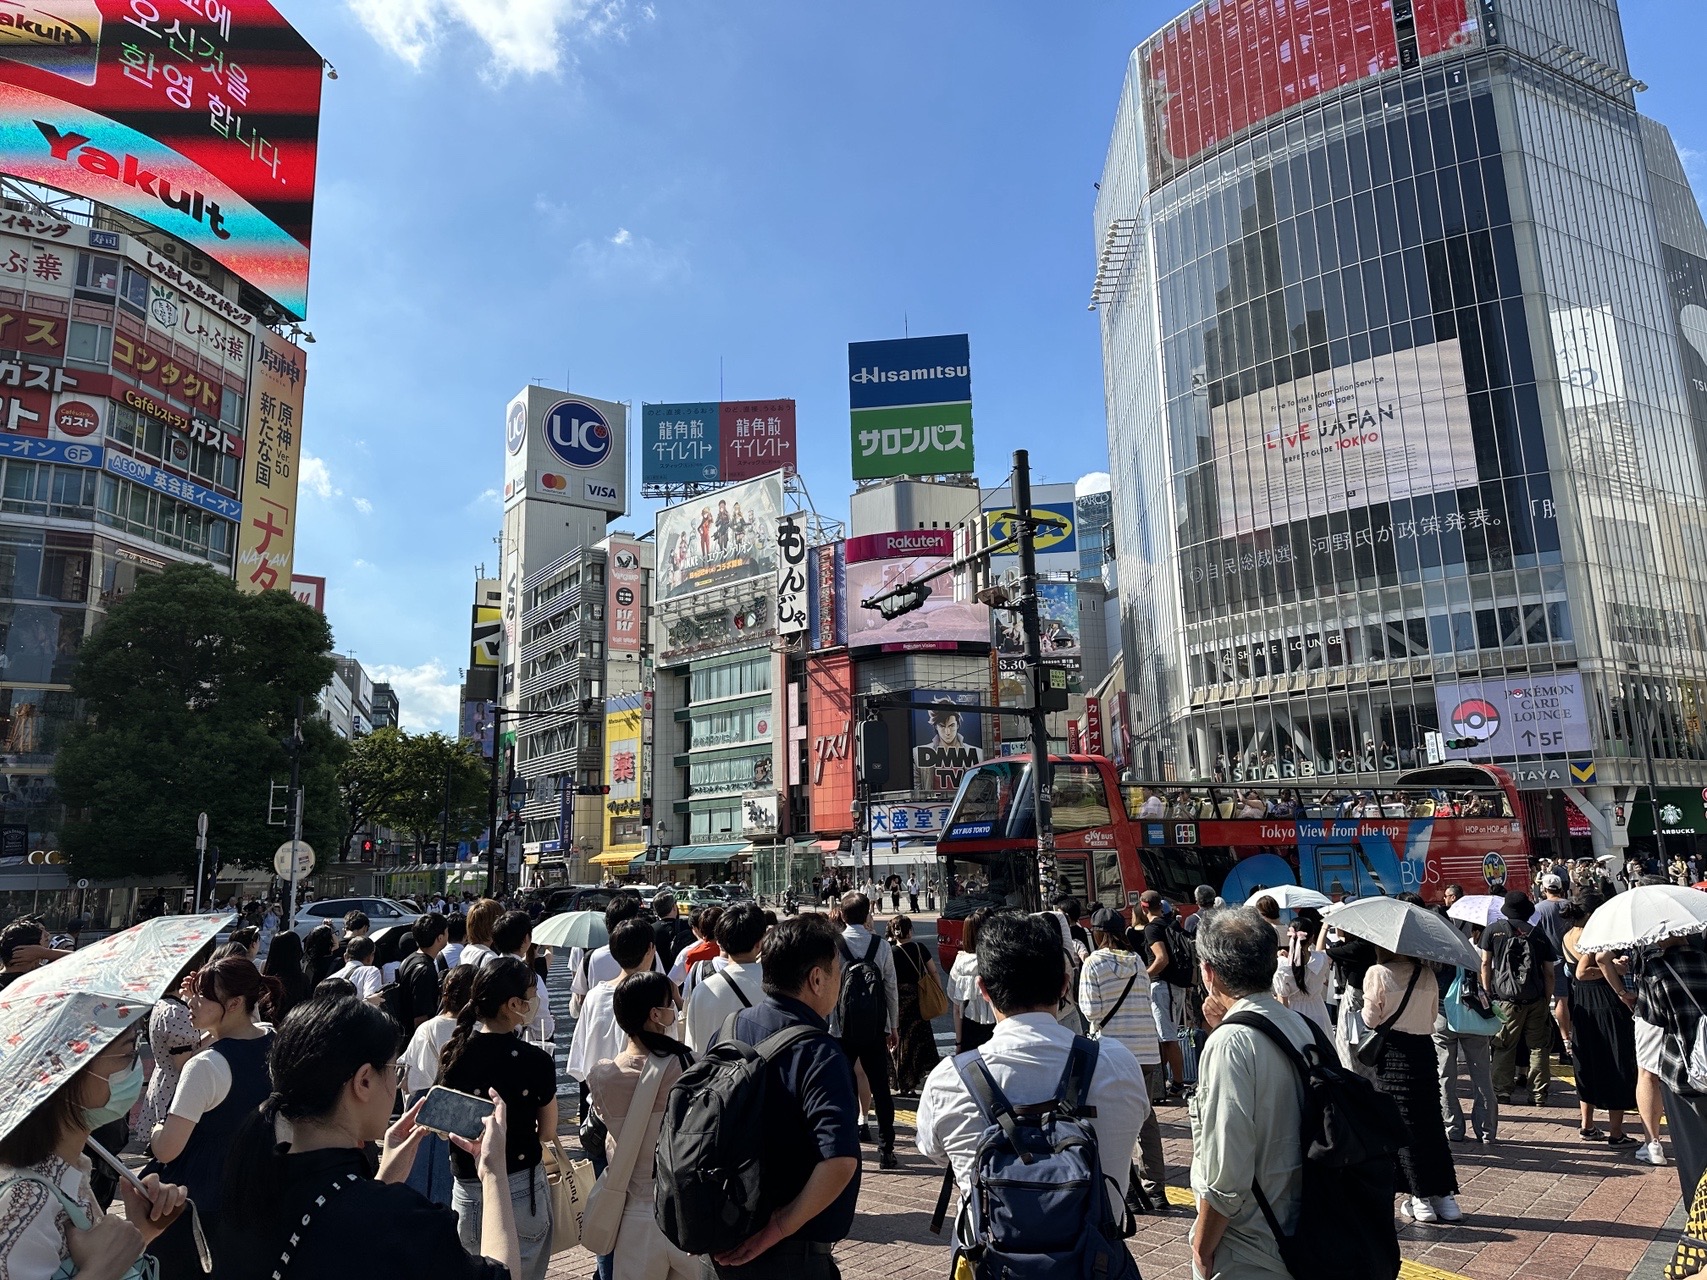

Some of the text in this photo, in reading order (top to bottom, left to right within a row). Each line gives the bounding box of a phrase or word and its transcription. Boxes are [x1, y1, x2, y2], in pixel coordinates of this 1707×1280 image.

[119, 42, 193, 109] 환영
[32, 119, 231, 240] Yakult
[92, 233, 117, 247] 寿司
[184, 308, 244, 362] しゃぶ葉
[113, 336, 217, 406] コンタクト
[851, 365, 968, 384] Hisamitsu
[1307, 404, 1313, 412] 8
[60, 415, 94, 428] ガスト
[508, 413, 526, 443] UC
[658, 419, 705, 440] 龍角散
[736, 416, 782, 437] 龍角散
[1319, 403, 1394, 437] JAPAN
[190, 419, 235, 453] ガスト
[255, 391, 277, 490] 新たな国
[275, 401, 293, 478] 原神 Ver. 5.0
[552, 414, 607, 453] UC
[858, 424, 966, 457] サロンパス
[1334, 432, 1379, 450] TOKYO
[67, 448, 89, 460] 6F
[652, 440, 713, 461] ダイレクト
[730, 438, 790, 458] ダイレクト
[112, 455, 147, 479] AEON
[586, 483, 617, 500] VISA
[887, 536, 944, 549] Rakuten
[1311, 508, 1501, 556] 河野氏が政策発表。
[777, 517, 806, 628] もんじゃ
[999, 659, 1026, 670] 8.30
[505, 671, 513, 685] 7F
[1521, 698, 1559, 710] CARD
[1514, 708, 1572, 722] LOUNGE
[1088, 704, 1101, 753] カラオケ
[1540, 731, 1563, 746] 5F
[613, 751, 636, 783] 薬
[917, 746, 979, 769] DMM
[1233, 754, 1397, 782] STARBUCKS
[935, 768, 964, 788] TV
[963, 827, 973, 835] BUS
[973, 825, 991, 834] TOKYO
[1084, 829, 1102, 844] SKY
[1177, 830, 1195, 838] JCB
[1260, 824, 1400, 842] Tokyo View from the top
[1465, 825, 1479, 833] HOP
[1486, 825, 1500, 833] HOP
[1400, 860, 1440, 885] BUS
[565, 1170, 579, 1204] Purely
